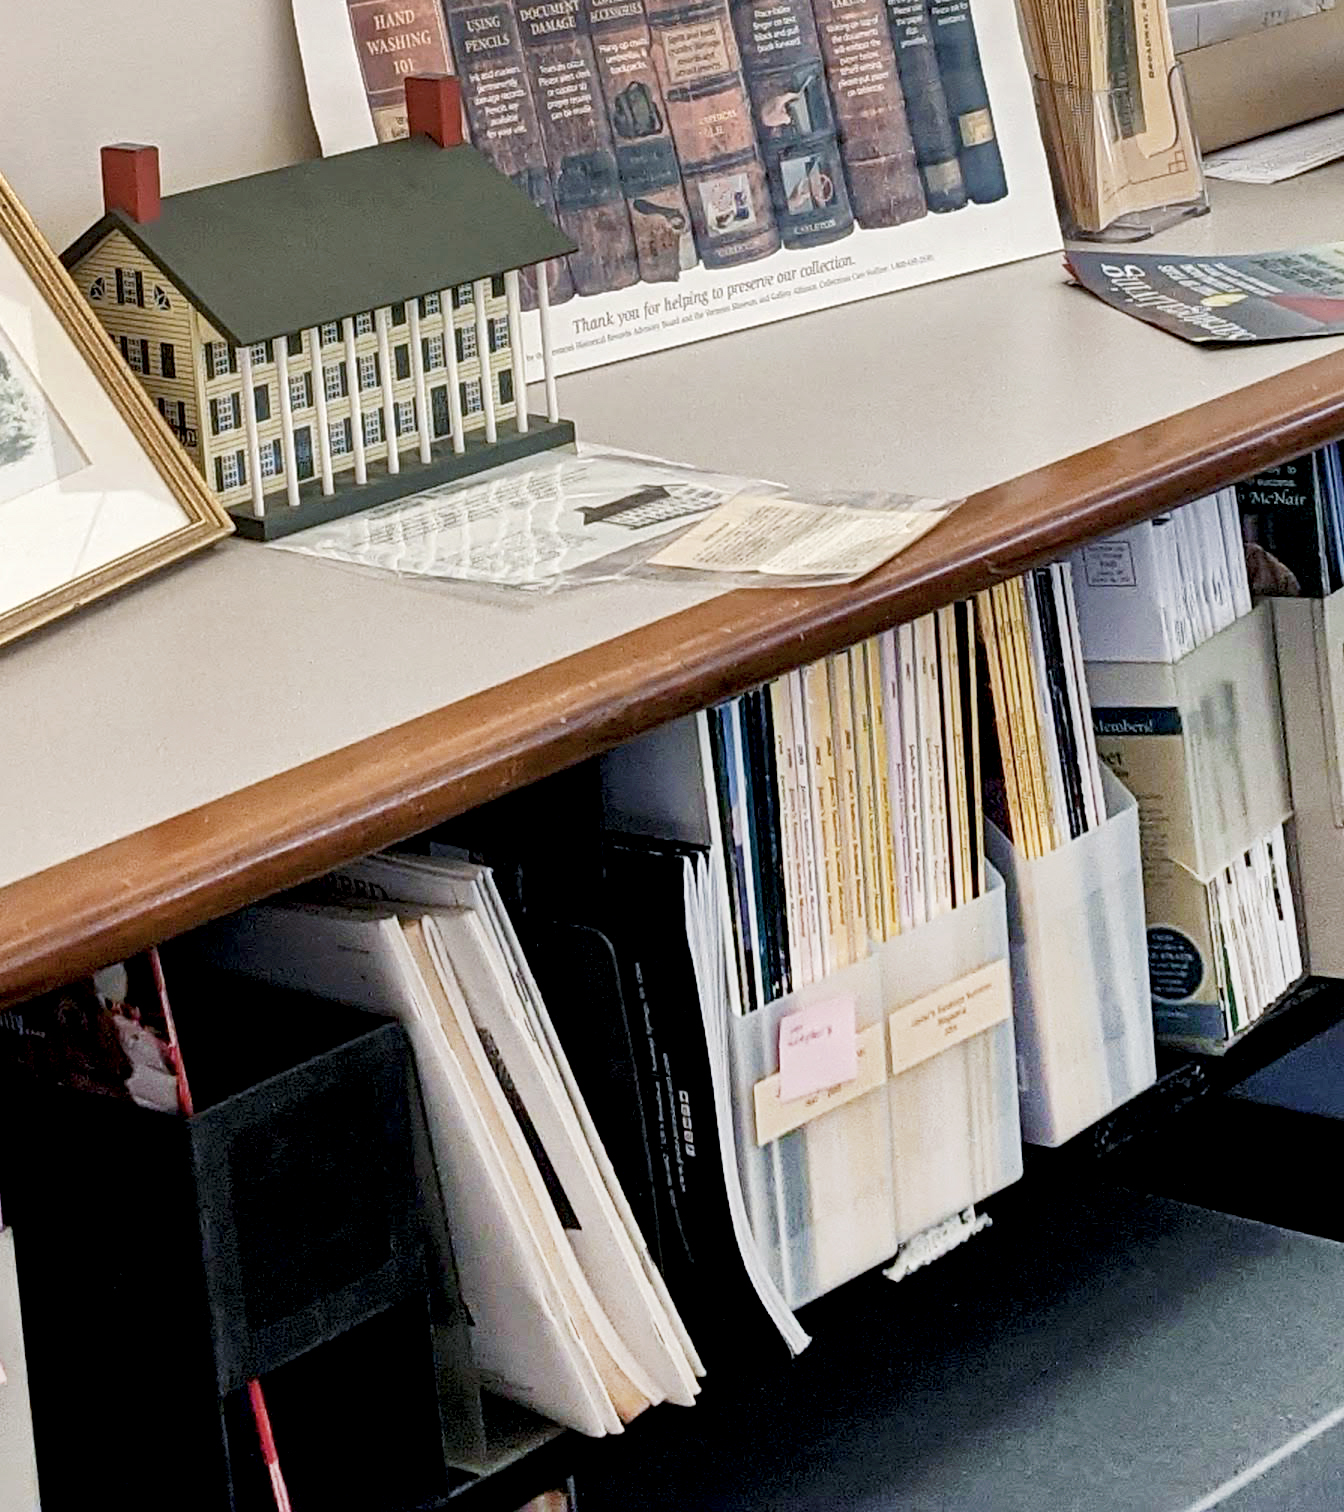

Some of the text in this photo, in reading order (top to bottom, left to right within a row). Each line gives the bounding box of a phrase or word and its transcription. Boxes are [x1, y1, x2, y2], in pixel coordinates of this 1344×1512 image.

[373, 9, 416, 32] HAND
[466, 15, 501, 34] USING
[530, 15, 578, 36] DAMAGE
[365, 29, 432, 57] WASHING
[464, 33, 511, 54] PENCILS
[393, 58, 415, 75] 101
[486, 128, 497, 139] for
[497, 127, 513, 139] your
[572, 254, 857, 334] Thank you for helping to preserve our collection.
[1250, 492, 1307, 507] McNair
